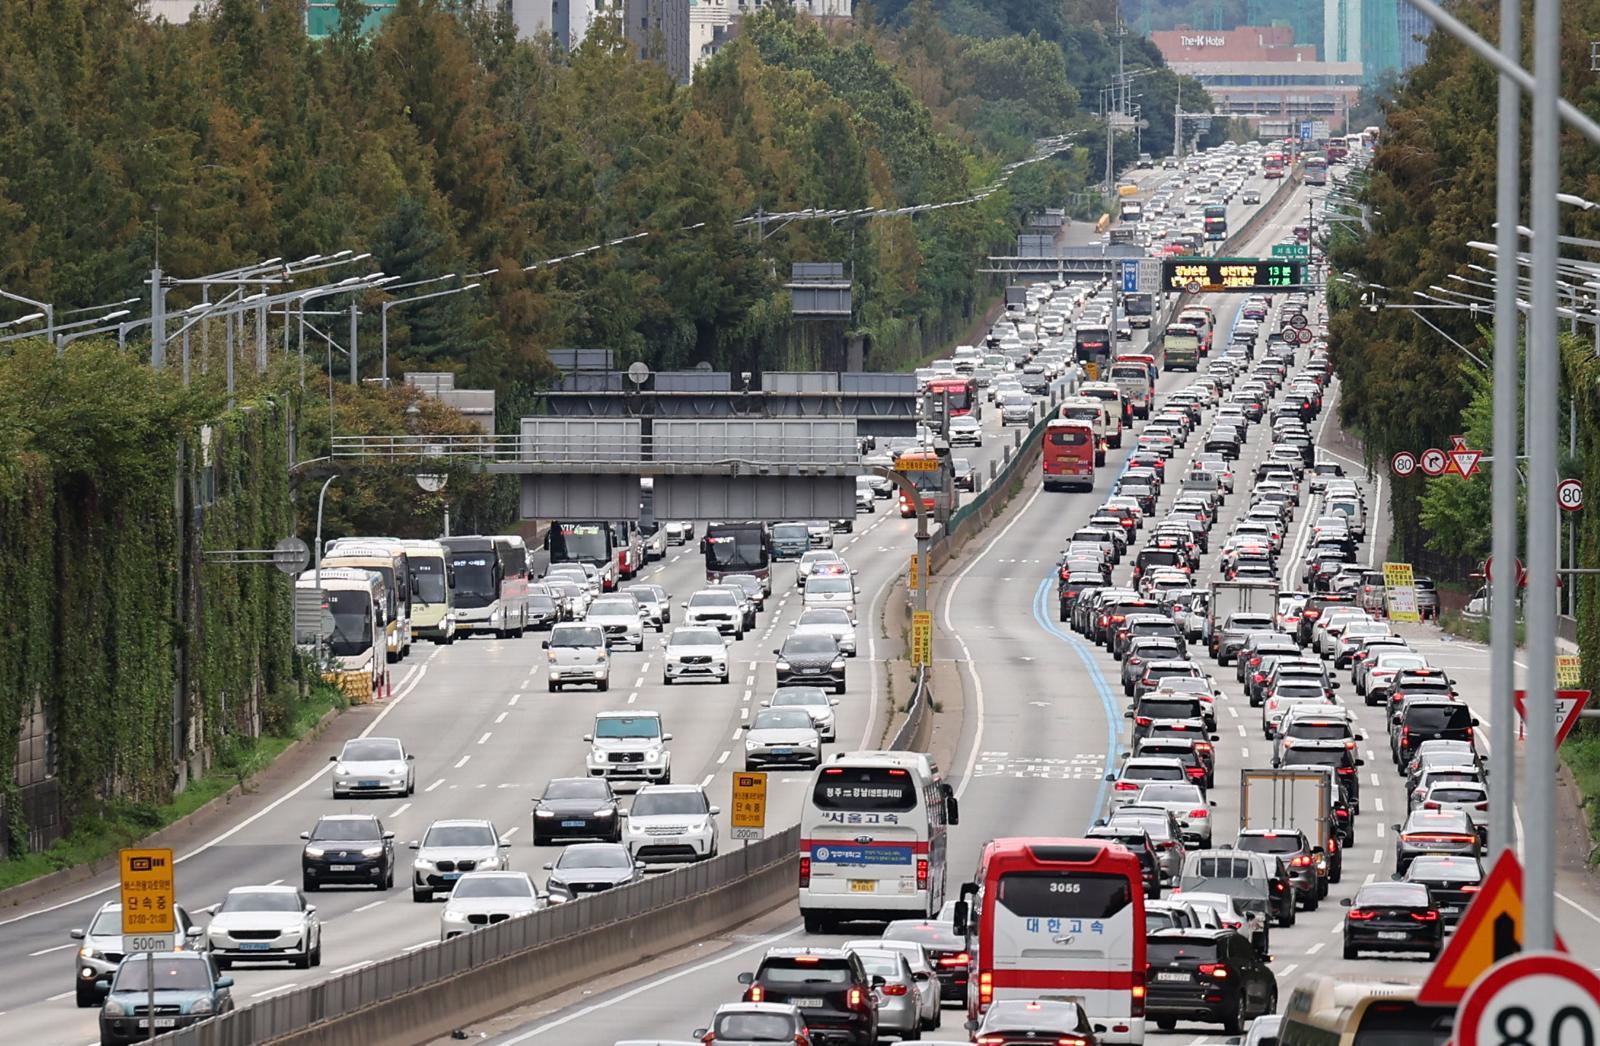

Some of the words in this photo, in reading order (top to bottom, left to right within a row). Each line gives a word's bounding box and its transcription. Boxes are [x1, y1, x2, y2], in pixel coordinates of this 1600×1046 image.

[1205, 36, 1225, 46] Hotel
[1268, 267, 1279, 276] 13
[1282, 266, 1292, 276] 분
[1268, 277, 1279, 286] 17
[1397, 458, 1412, 471] 80
[1562, 488, 1582, 503] 80
[736, 829, 759, 838] 200m
[1049, 882, 1081, 893] 3055
[132, 937, 166, 951] 500m
